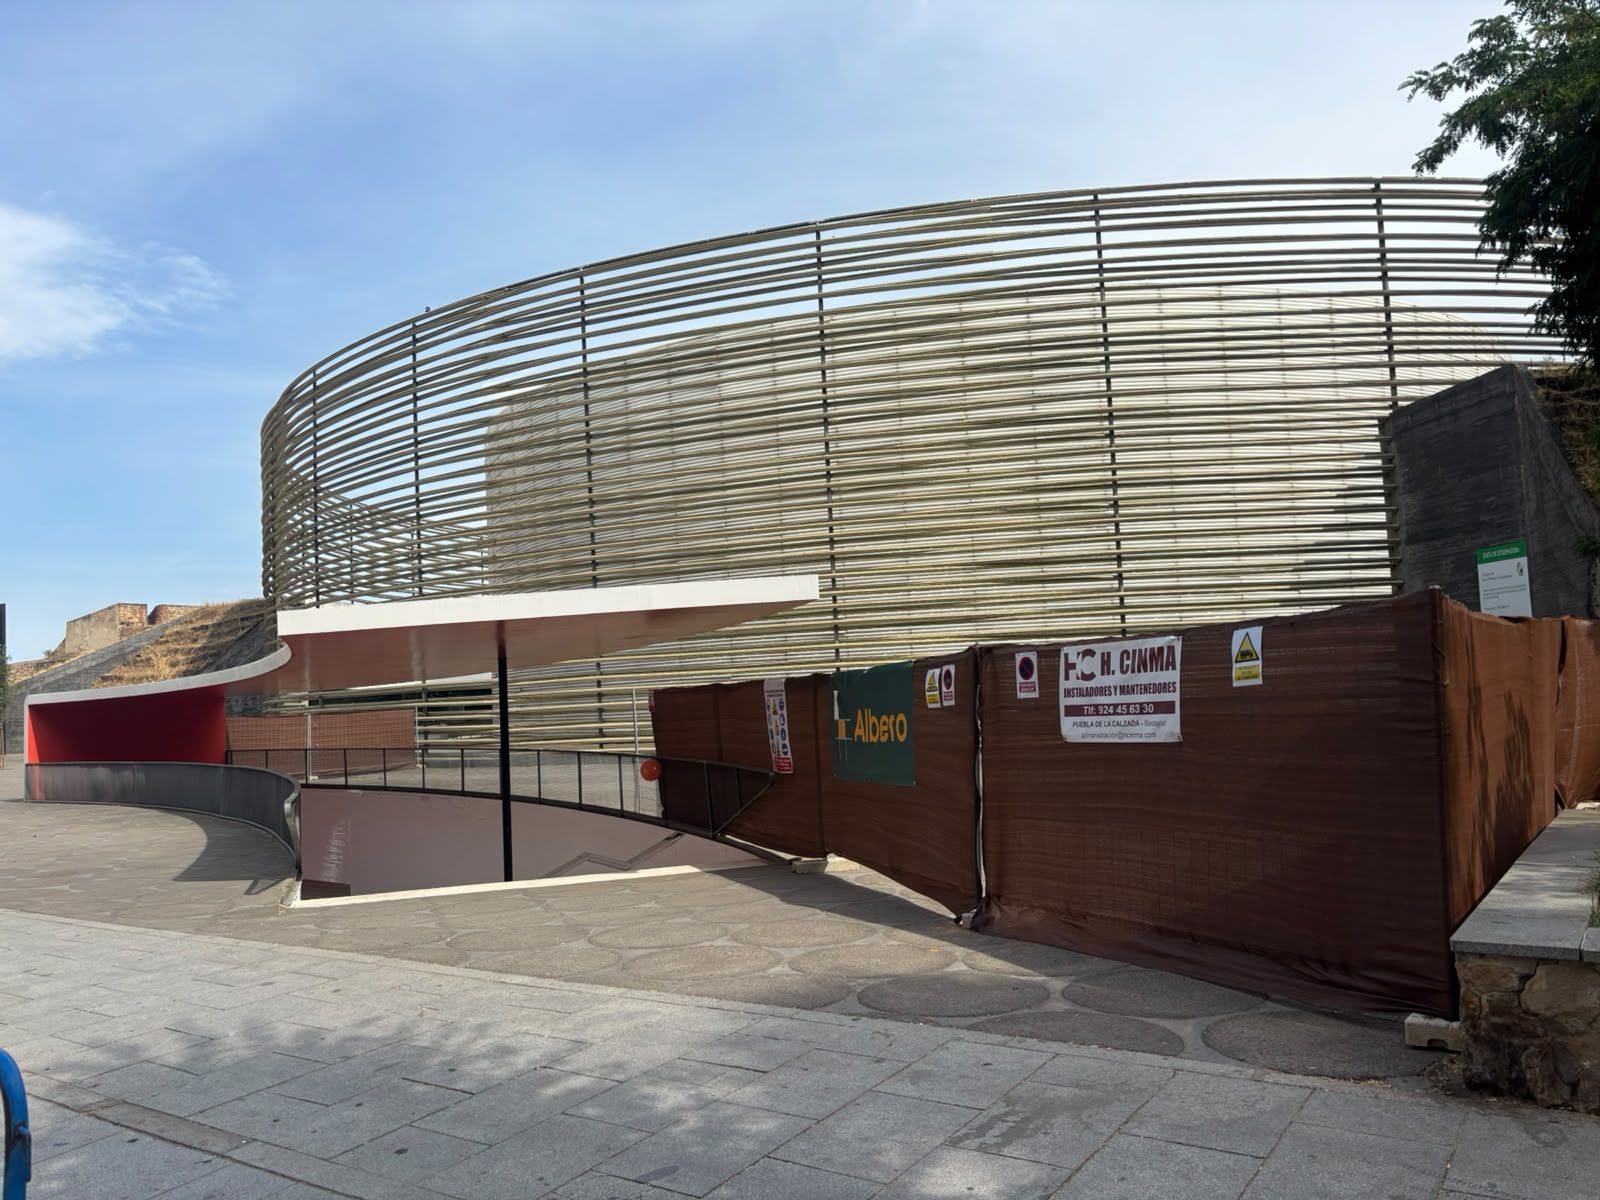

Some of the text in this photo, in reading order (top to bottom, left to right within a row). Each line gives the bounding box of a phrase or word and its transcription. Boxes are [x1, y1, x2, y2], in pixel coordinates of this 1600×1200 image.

[1064, 648, 1097, 682] HC
[1101, 645, 1177, 677] H. CINMA
[1064, 681, 1177, 699] INSTALADORES Y MANTENEDORES
[1082, 703, 1154, 715] Tlf: 924 45 63 30
[854, 708, 908, 743] Albero
[1072, 719, 1094, 728] PUEBLA
[1095, 719, 1103, 727] DE
[1104, 719, 1111, 727] LA
[1112, 719, 1140, 727] CALZADA
[1144, 718, 1167, 728] Badajoz
